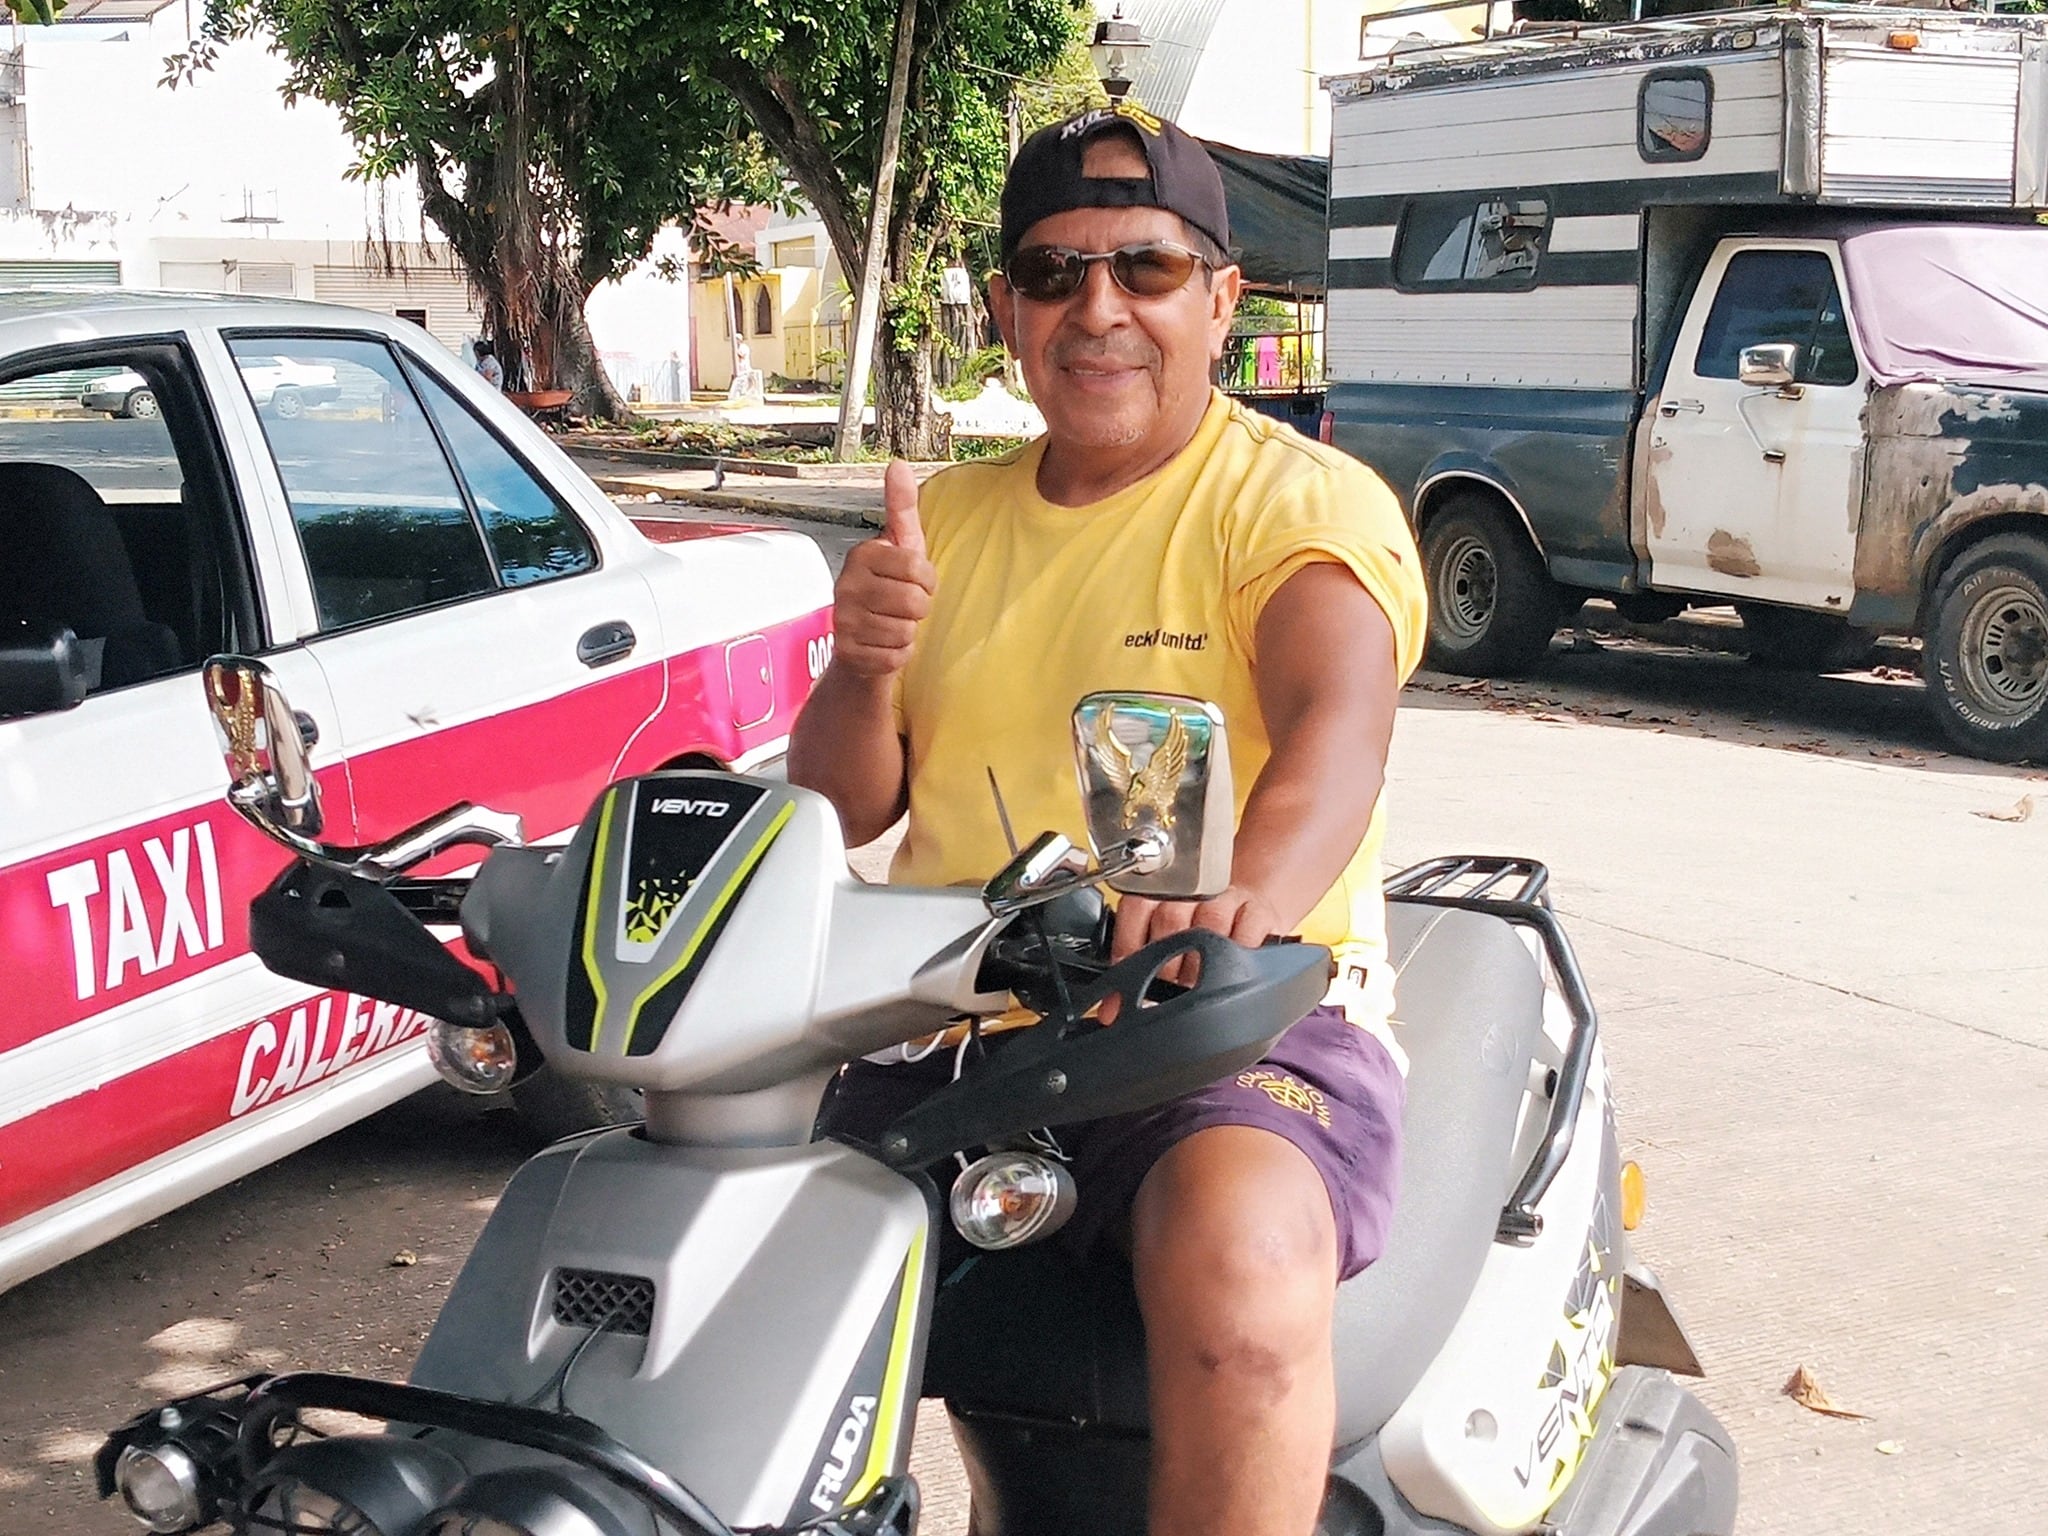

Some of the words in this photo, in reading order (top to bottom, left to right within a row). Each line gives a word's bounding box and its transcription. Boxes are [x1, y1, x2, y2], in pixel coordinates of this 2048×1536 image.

[650, 798, 730, 818] VENTO
[46, 820, 225, 1001] TAXI
[809, 1395, 878, 1513] RUDA
